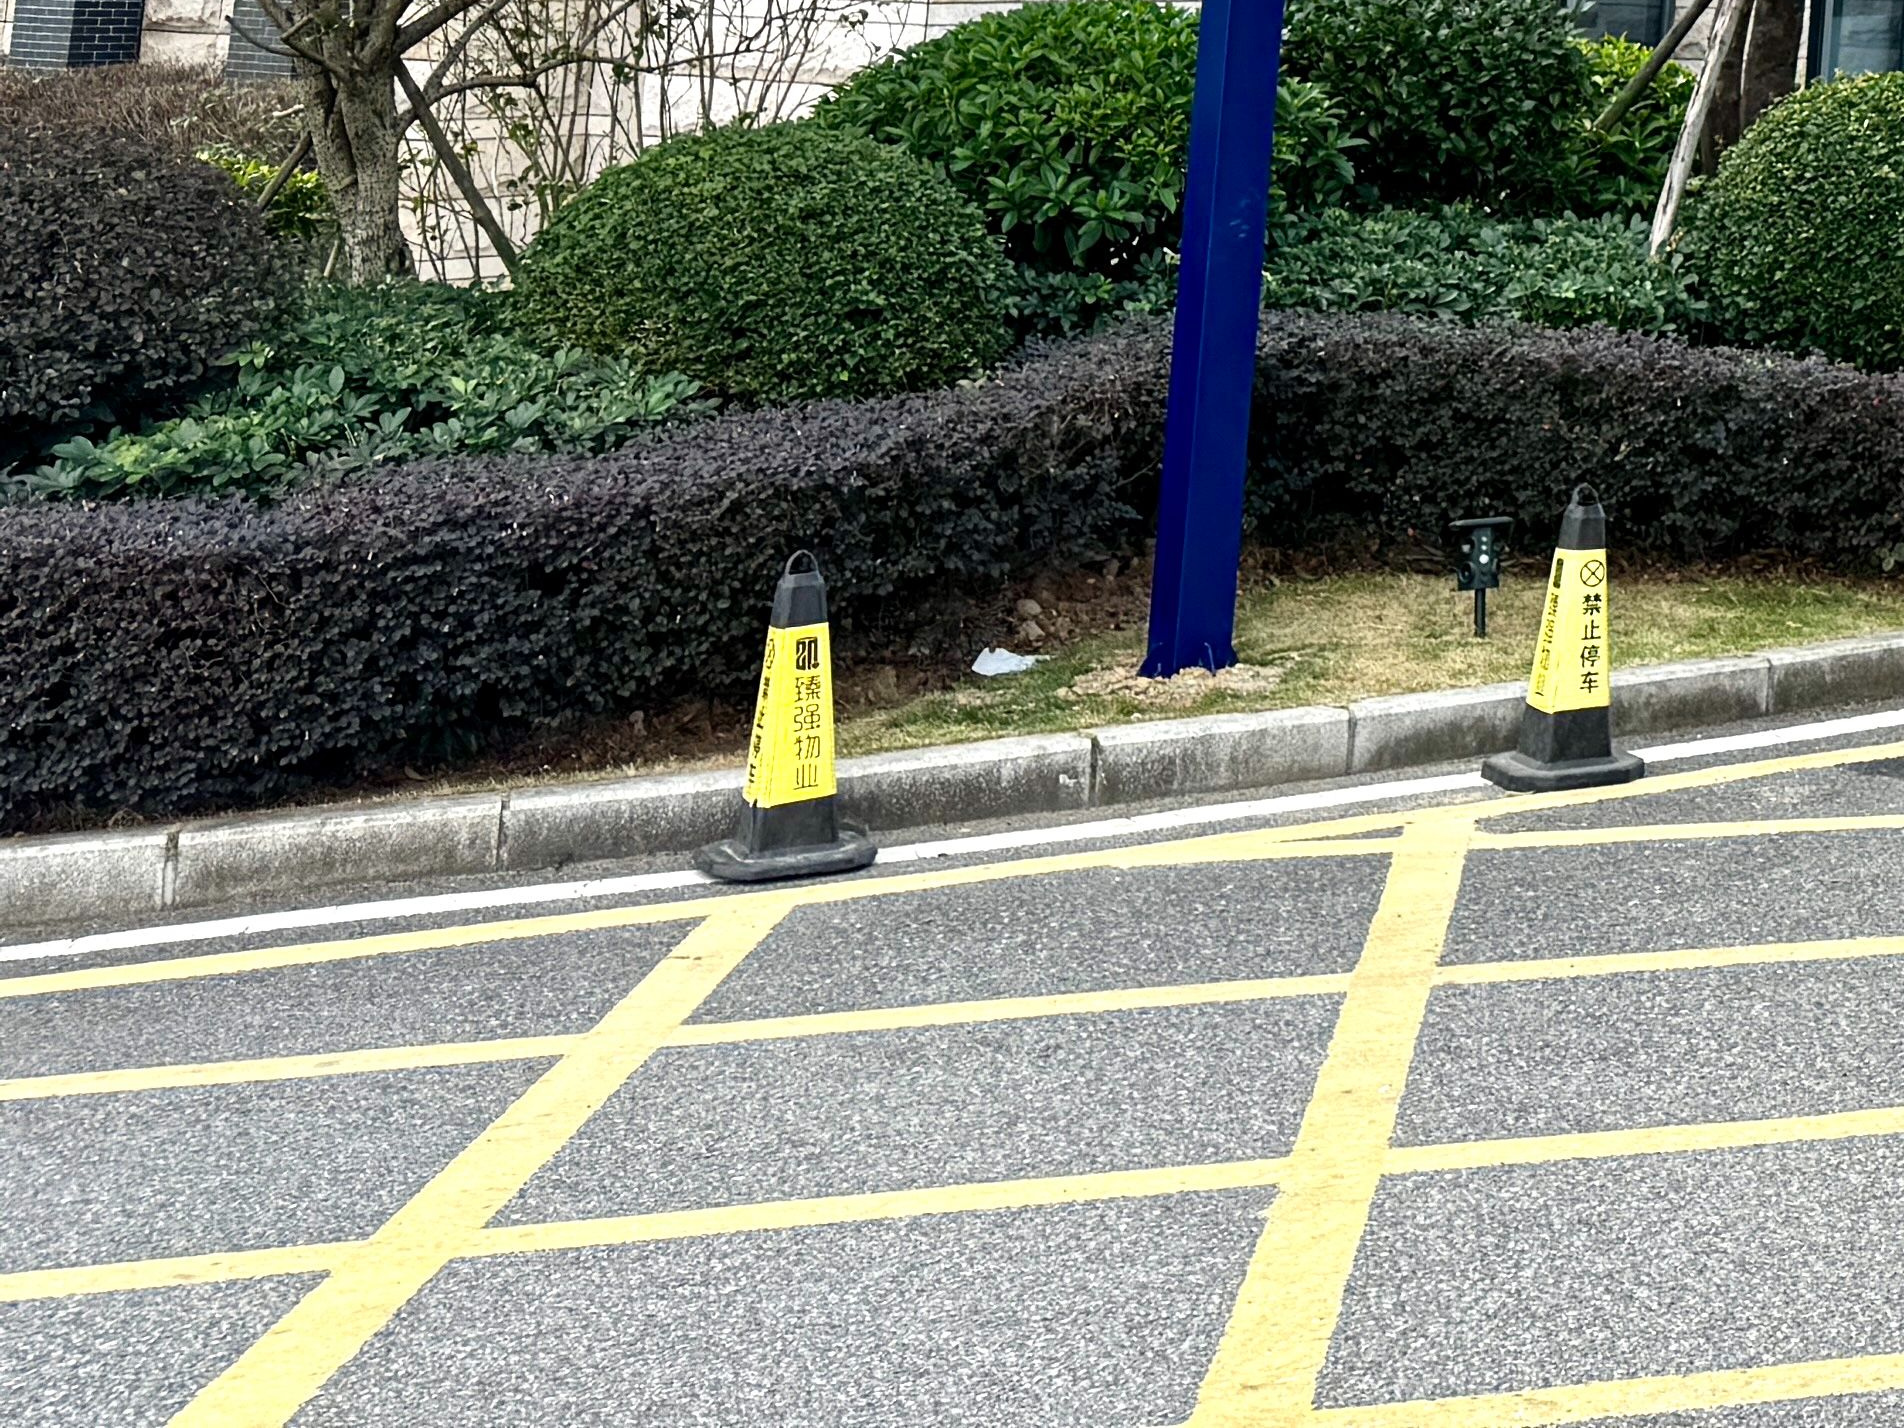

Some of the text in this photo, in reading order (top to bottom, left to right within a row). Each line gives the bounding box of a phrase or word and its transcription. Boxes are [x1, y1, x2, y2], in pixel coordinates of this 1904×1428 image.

[1580, 593, 1602, 694] 禁止停车
[793, 674, 821, 790] 臻强物业
